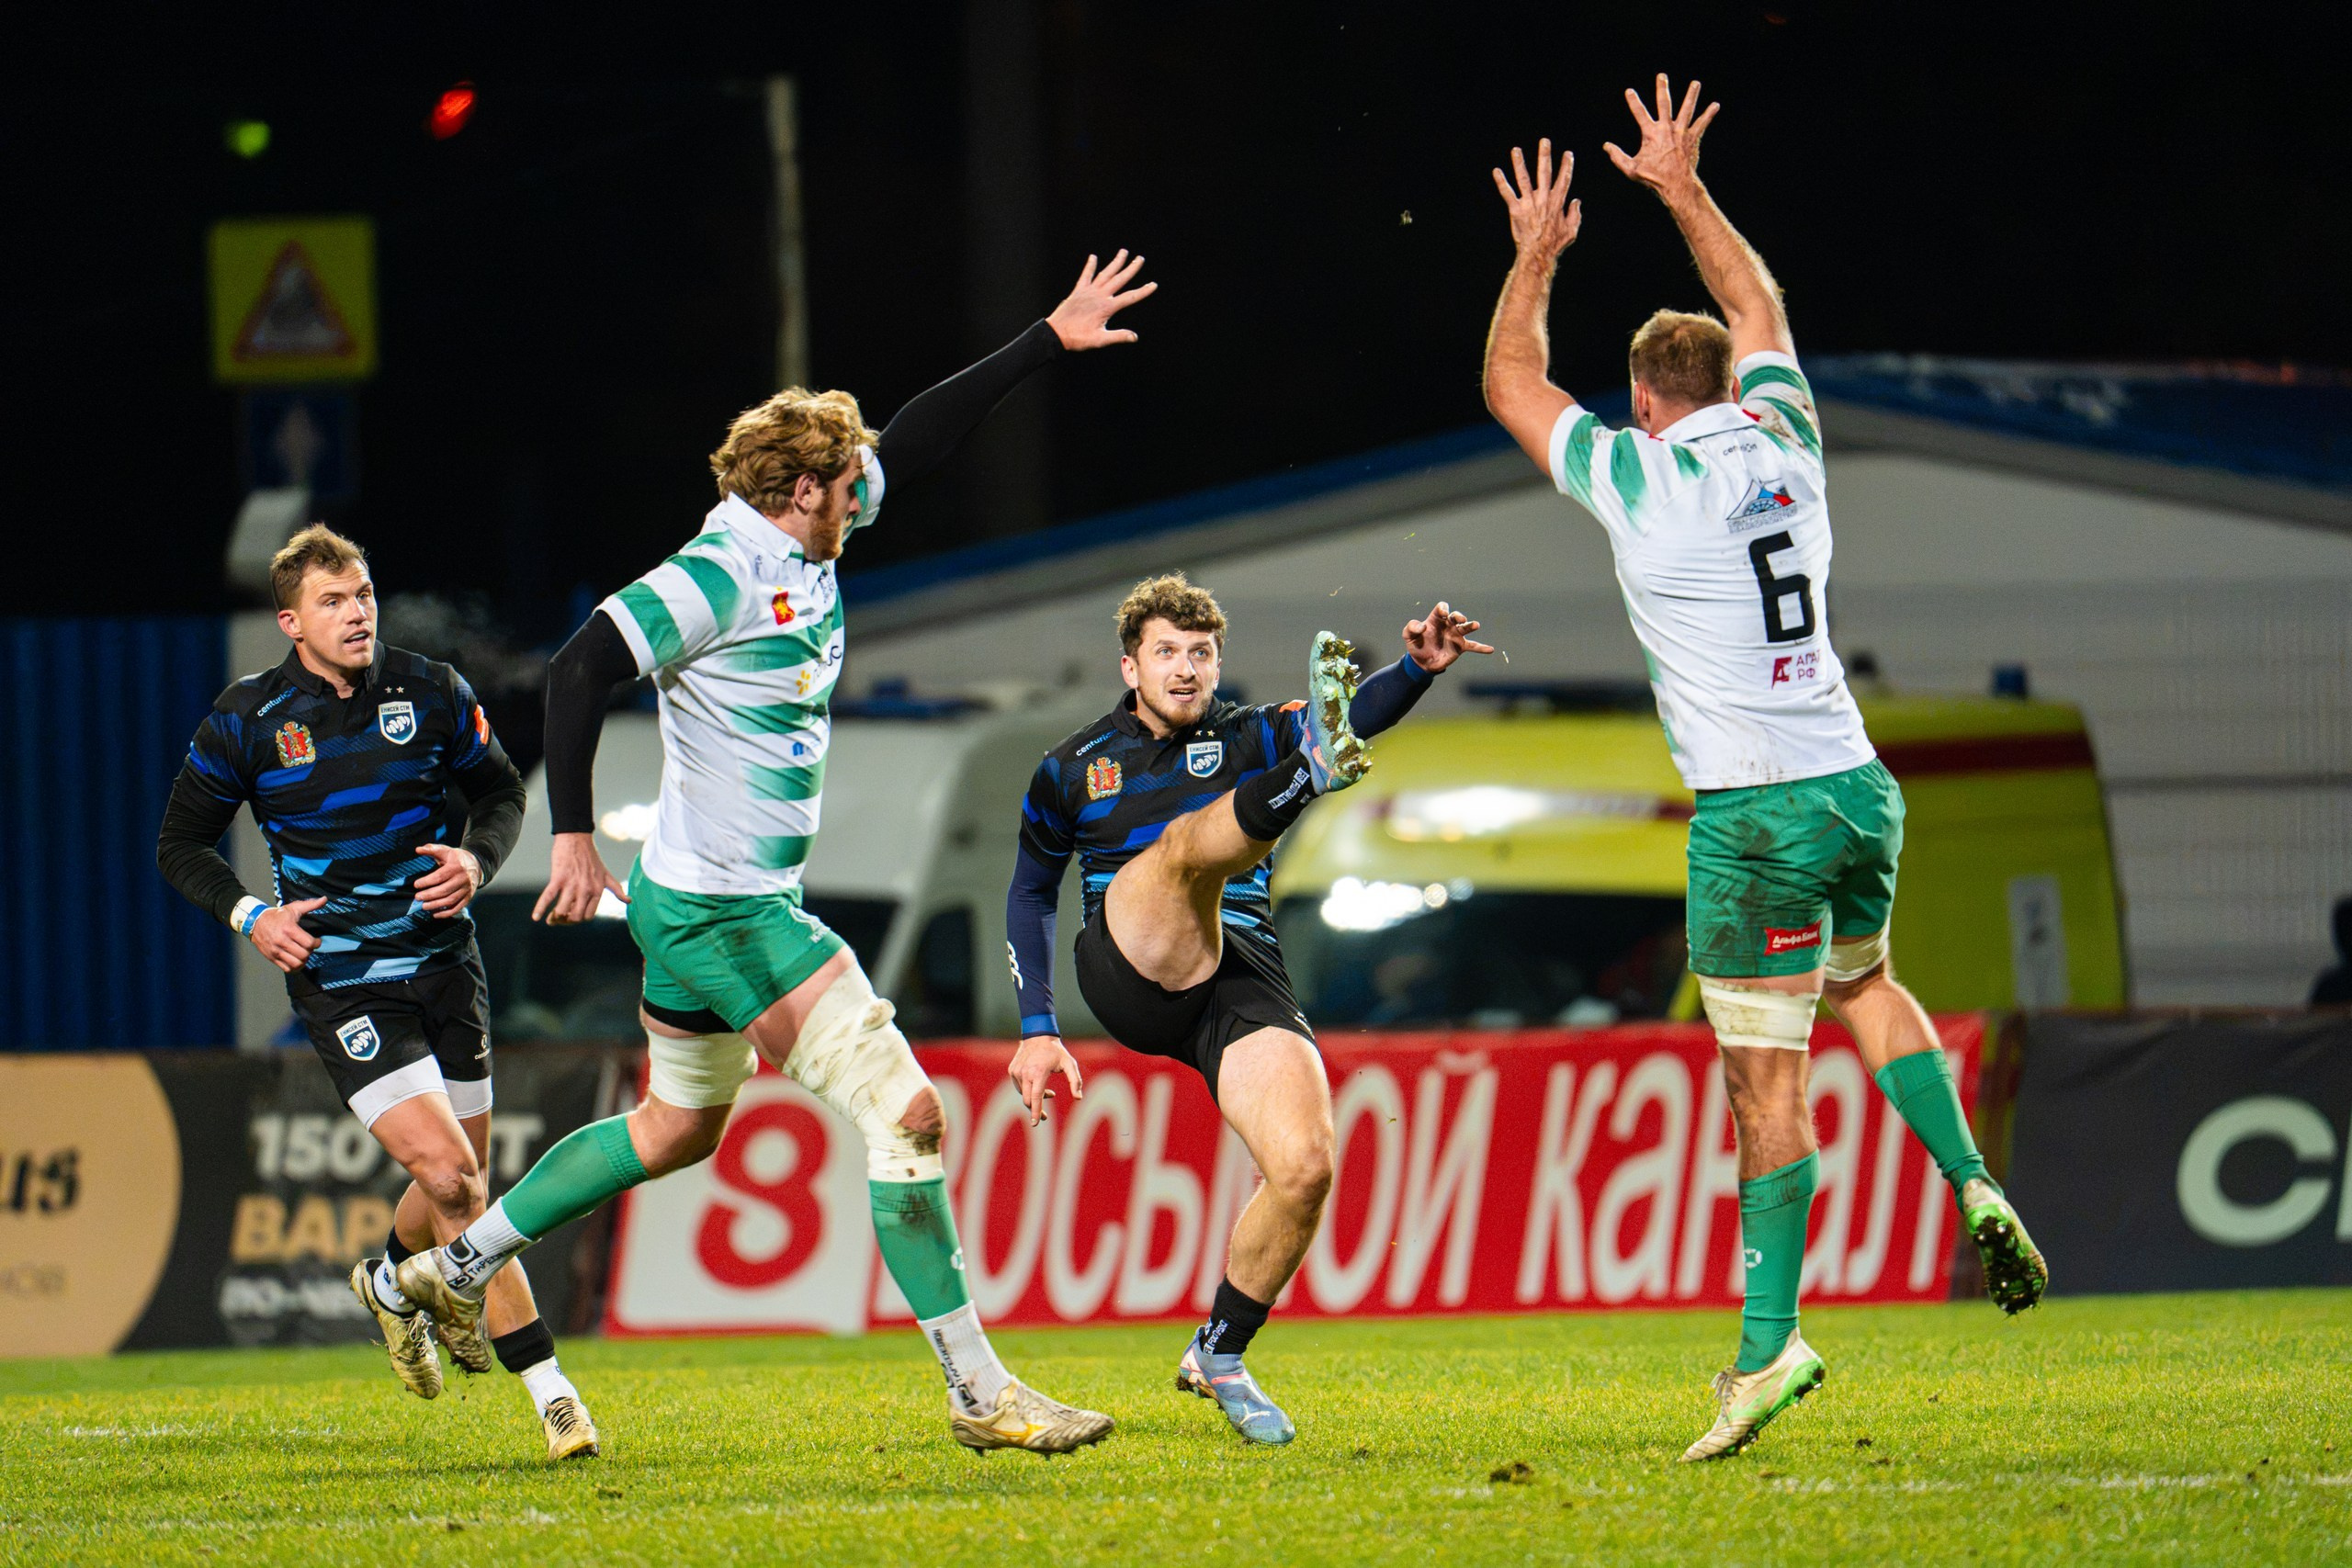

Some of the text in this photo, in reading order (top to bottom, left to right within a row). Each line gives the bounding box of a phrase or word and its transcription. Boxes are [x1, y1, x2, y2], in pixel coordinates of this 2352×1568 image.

[1748, 530, 1815, 643] 6
[380, 705, 400, 714] ЕНИСЕЙ
[1797, 668, 1815, 681] РФ
[340, 1019, 368, 1037] ЕНИСЕЙ СТМ
[250, 1113, 380, 1183] 150
[231, 1194, 397, 1264] ВАР
[693, 1100, 828, 1288] 8
